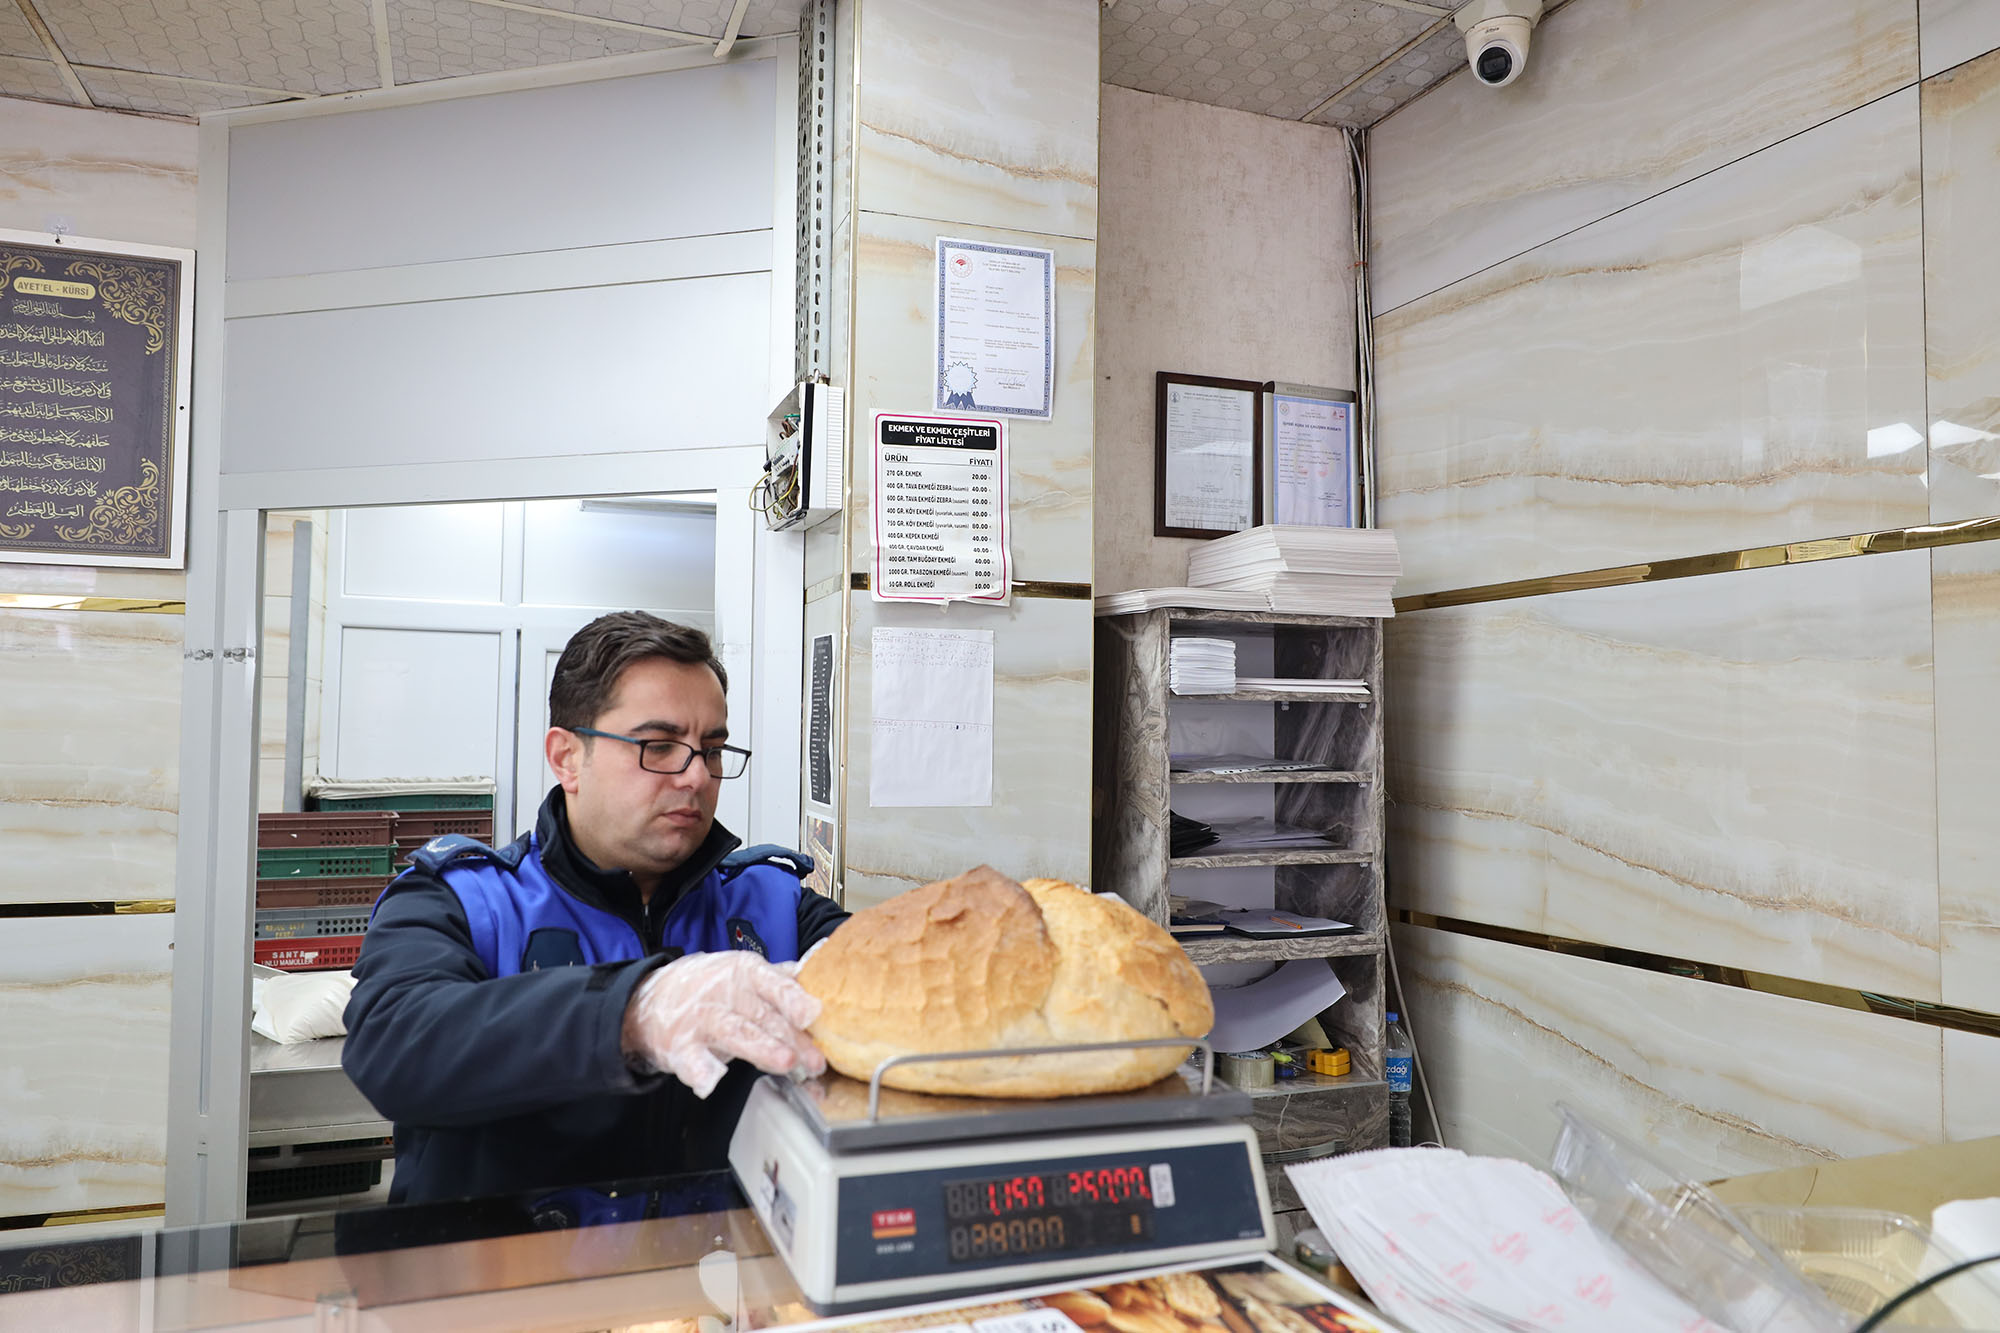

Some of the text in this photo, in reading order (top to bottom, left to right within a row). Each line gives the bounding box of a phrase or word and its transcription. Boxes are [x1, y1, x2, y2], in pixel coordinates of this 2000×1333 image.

[17, 281, 54, 293] AYET'EL
[62, 285, 89, 296] KÜRSİ
[888, 424, 991, 438] EKMEK VE EKMEK ÇEŞİTLERİ
[915, 435, 965, 446] FİYAT LİSTESİ
[884, 452, 908, 462] ÜRÜN
[969, 457, 993, 466] FİYATI
[971, 473, 988, 481] 20.00
[918, 482, 936, 491] EKMEĞİ
[918, 495, 936, 503] EKMEĞİ
[905, 507, 915, 515] KÖY
[916, 507, 935, 516] EKMEĞİ
[905, 519, 915, 527] KÖY
[916, 520, 935, 528] EKMEĞİ
[905, 532, 921, 540] KEPEK
[921, 532, 939, 541] EKMEĞİ
[918, 555, 938, 563] BUĞDAY
[938, 556, 956, 564] EKMEĞİ
[909, 568, 933, 576] TRABZON
[933, 568, 951, 576] EKMEĞİ
[917, 580, 935, 588] EKMEĞİ
